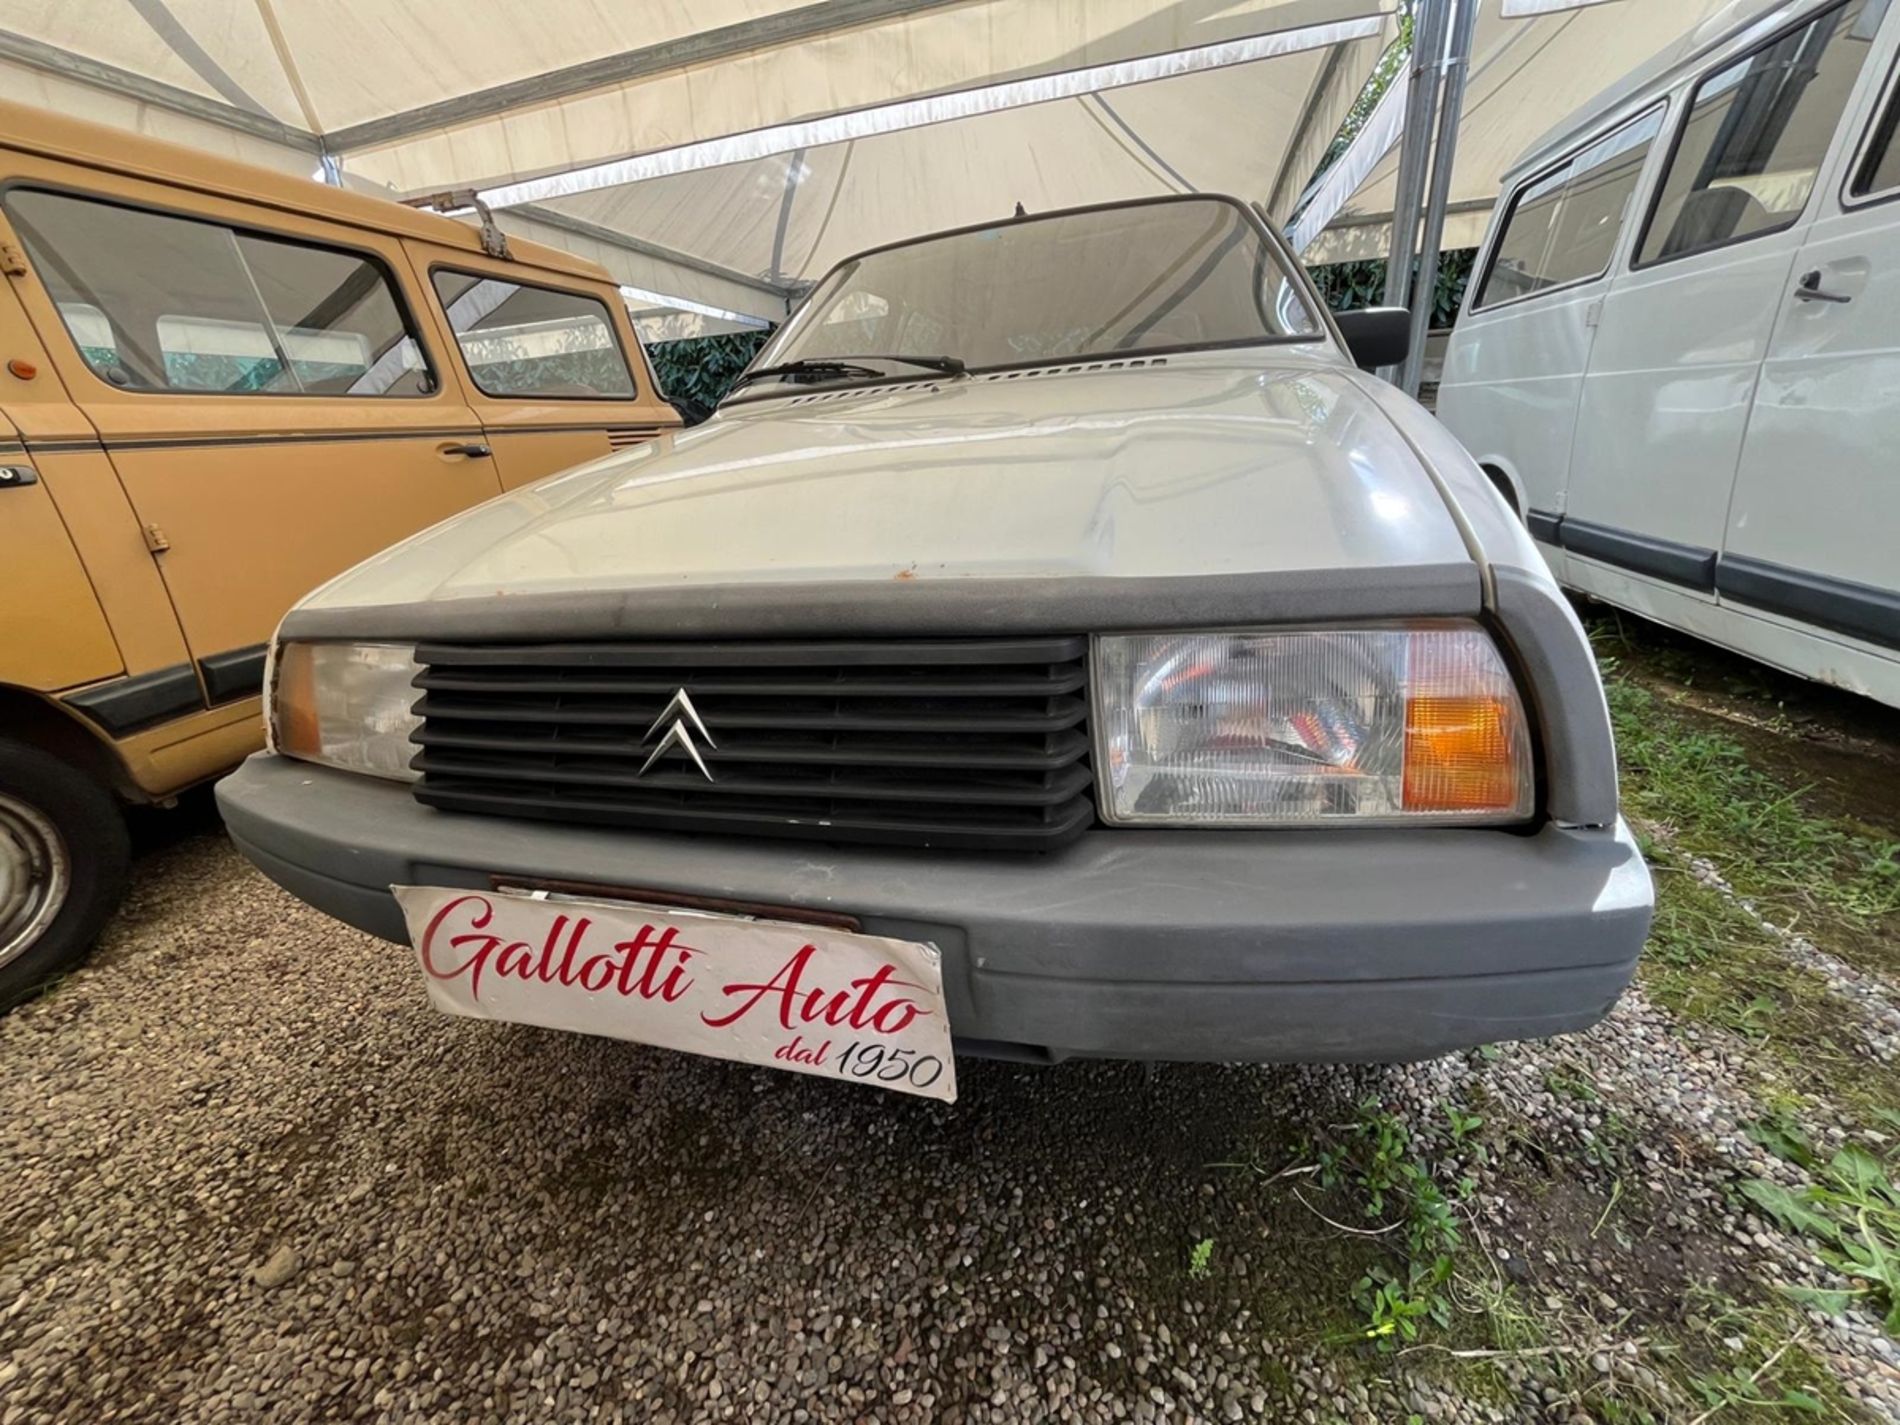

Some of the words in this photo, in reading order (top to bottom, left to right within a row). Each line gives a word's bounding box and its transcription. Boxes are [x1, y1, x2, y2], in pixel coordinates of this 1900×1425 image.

[421, 896, 707, 1002] Gallotti
[701, 944, 937, 1034] Auto
[775, 1036, 830, 1066] dal
[836, 1041, 943, 1088] 1950
